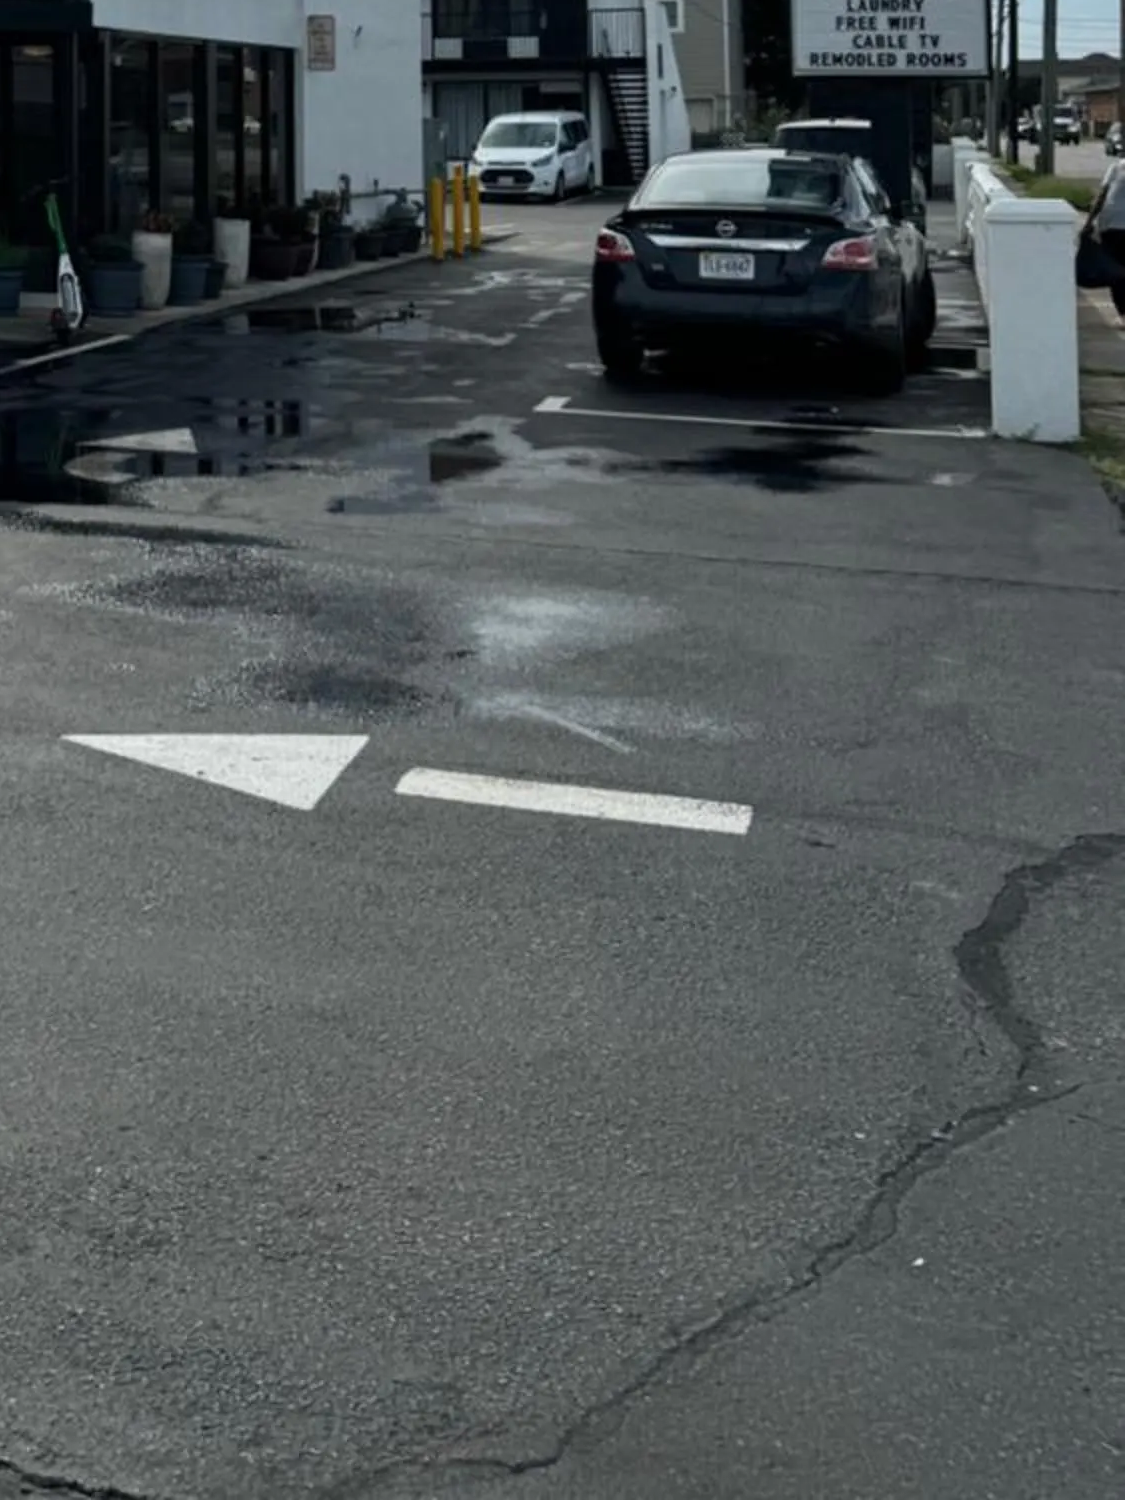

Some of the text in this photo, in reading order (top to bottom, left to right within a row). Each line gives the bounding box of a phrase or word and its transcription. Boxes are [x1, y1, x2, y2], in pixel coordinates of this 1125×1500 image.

[835, 16, 926, 32] FREE WIFI
[852, 34, 940, 49] CABLE TV
[809, 52, 968, 67] REMODLED ROOMS
